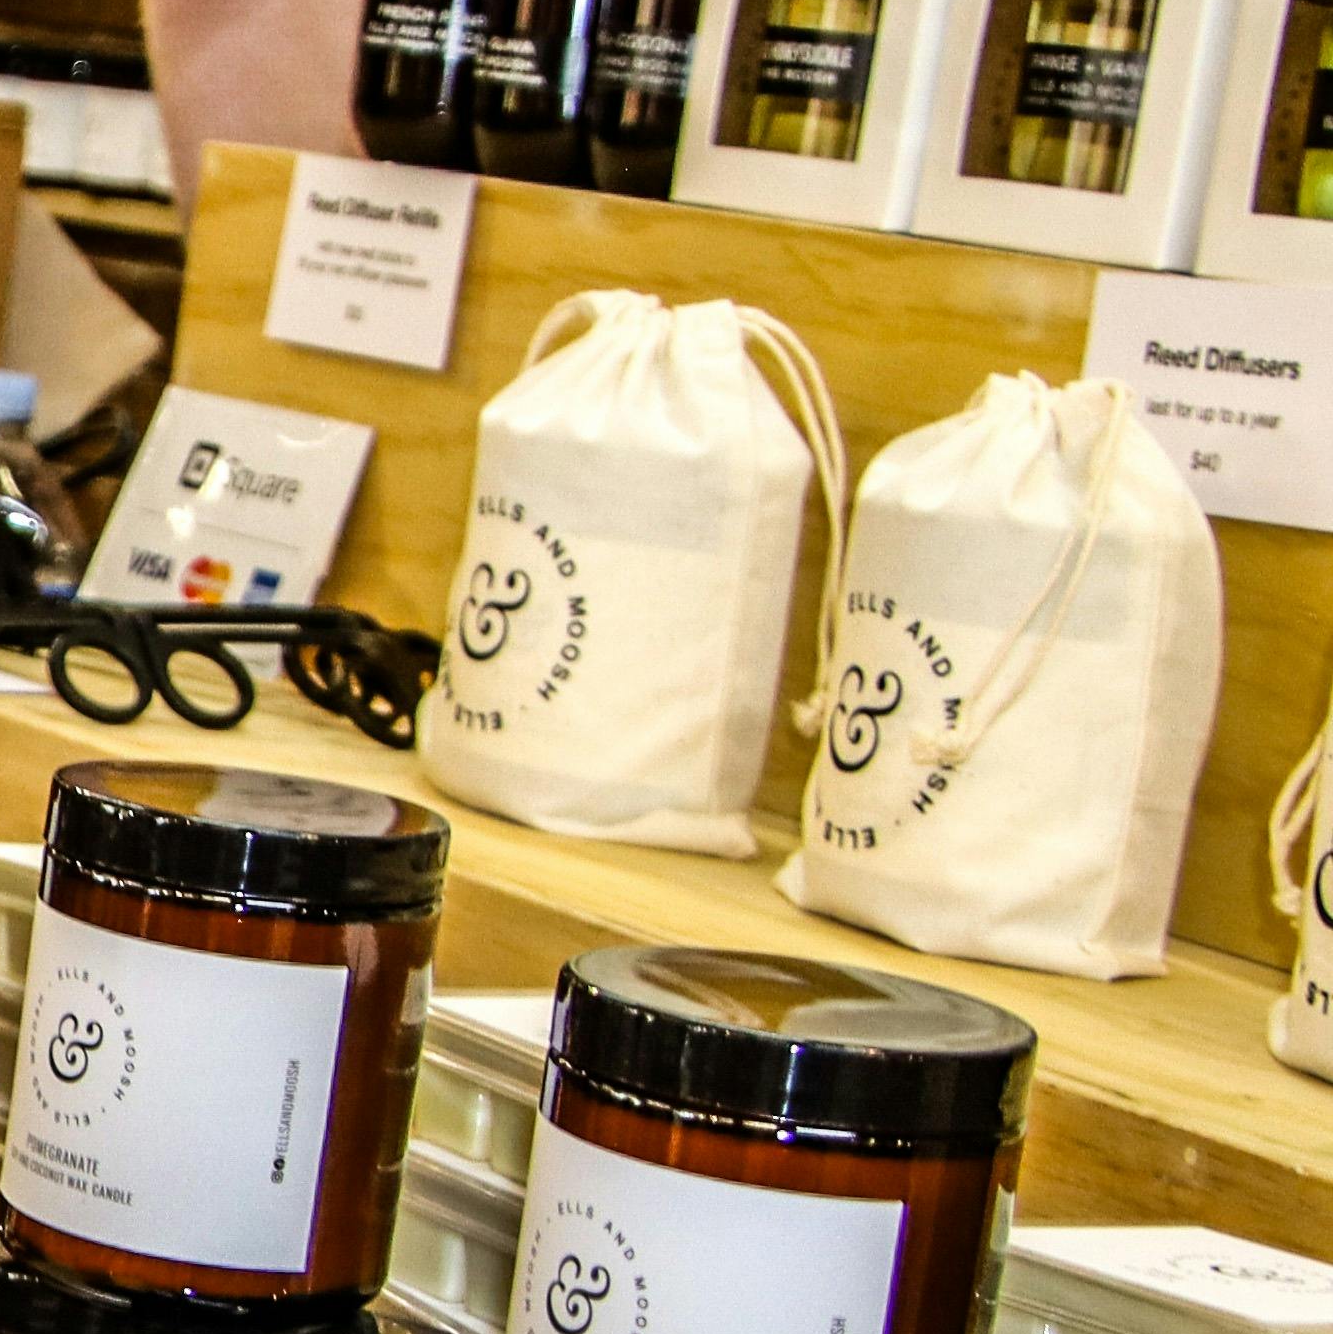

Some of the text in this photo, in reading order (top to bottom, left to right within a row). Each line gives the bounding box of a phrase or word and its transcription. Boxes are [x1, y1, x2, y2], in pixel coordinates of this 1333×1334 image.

[1143, 340, 1301, 380] Reed Diffusers
[128, 547, 174, 583] VISA
[478, 495, 587, 701] ELLS AND MOOSH
[459, 562, 531, 661] &
[829, 664, 903, 773] &
[848, 591, 962, 815] ELLS AND MSH
[48, 1012, 104, 1084] &
[57, 969, 137, 1101] ELLS AND MOOSH
[26, 1132, 100, 1177] POMEGRANATE
[67, 1175, 88, 1195] WAX
[92, 1182, 133, 1206] CANDLE
[557, 1201, 595, 1219] ELLS
[604, 1220, 635, 1261] AND
